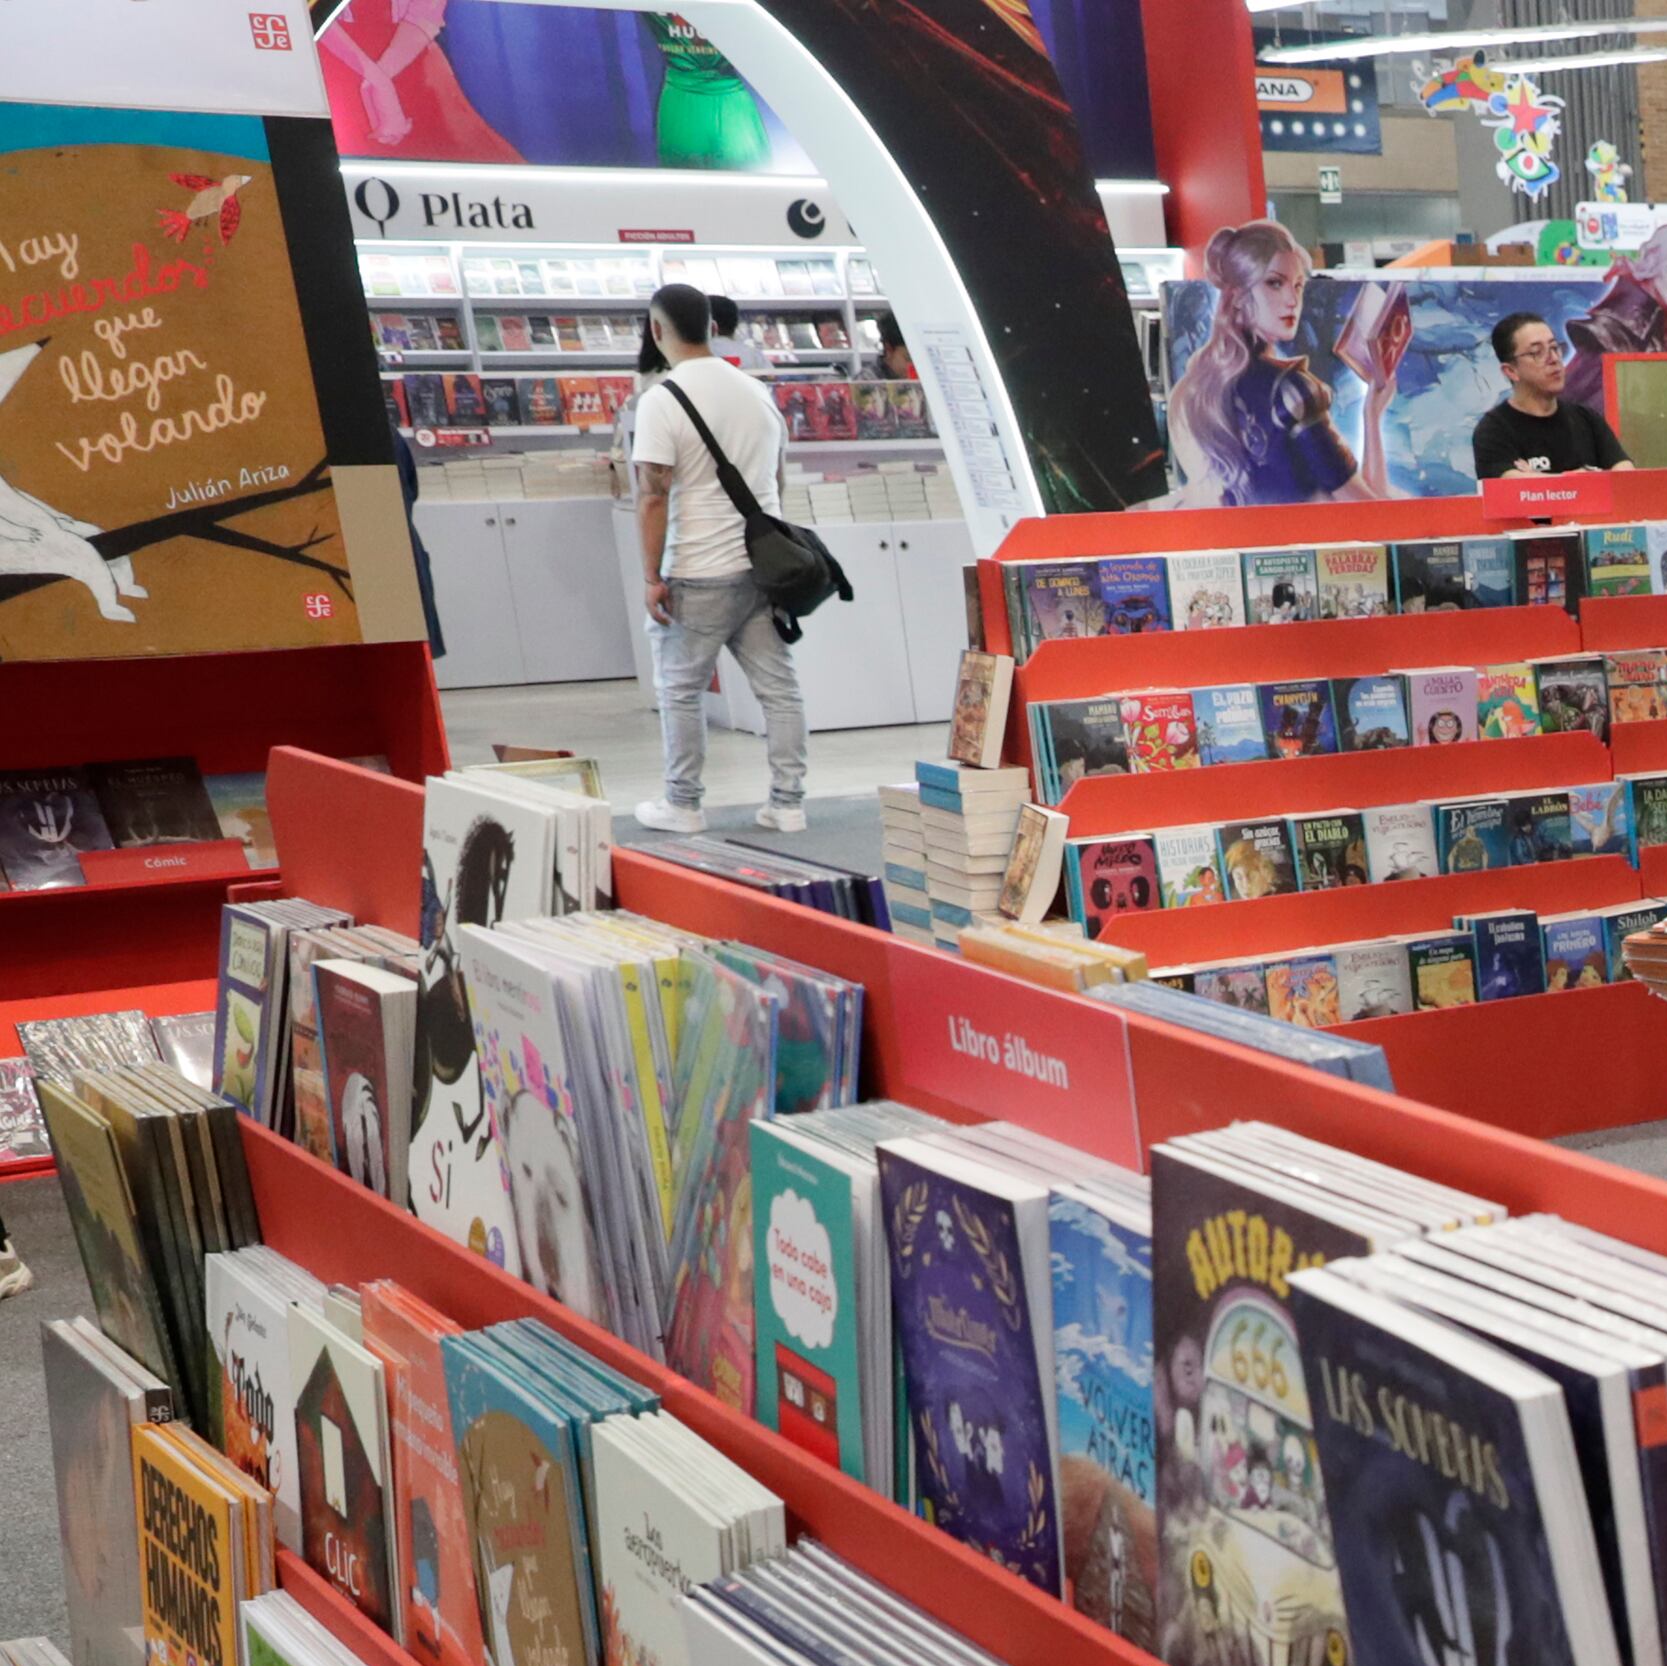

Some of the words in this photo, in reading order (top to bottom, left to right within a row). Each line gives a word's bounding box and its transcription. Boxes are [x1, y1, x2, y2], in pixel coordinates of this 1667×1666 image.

[418, 191, 535, 229] Plata
[94, 307, 162, 359] que
[59, 350, 207, 411] llegan
[55, 374, 267, 472] volando
[166, 478, 232, 510] Julián
[239, 464, 290, 489] Ariza
[1519, 487, 1543, 503] Plan
[1546, 485, 1578, 502] lector
[1603, 530, 1633, 546] Rudi
[1304, 829, 1315, 843] EL
[1316, 826, 1349, 841] DIABLO
[143, 855, 187, 869] Cómic
[1617, 911, 1658, 931] Shiloh
[1552, 933, 1597, 950] PRIMERO
[947, 1015, 1001, 1066] Libro
[1003, 1040, 1069, 1089] álbum
[772, 1261, 785, 1282] en
[786, 1267, 807, 1294] una
[800, 1249, 829, 1280] cabe
[1227, 1315, 1291, 1400] 666
[1318, 1357, 1372, 1443] LAS
[140, 1456, 220, 1594] DERECHOS
[643, 1510, 665, 1550] Los
